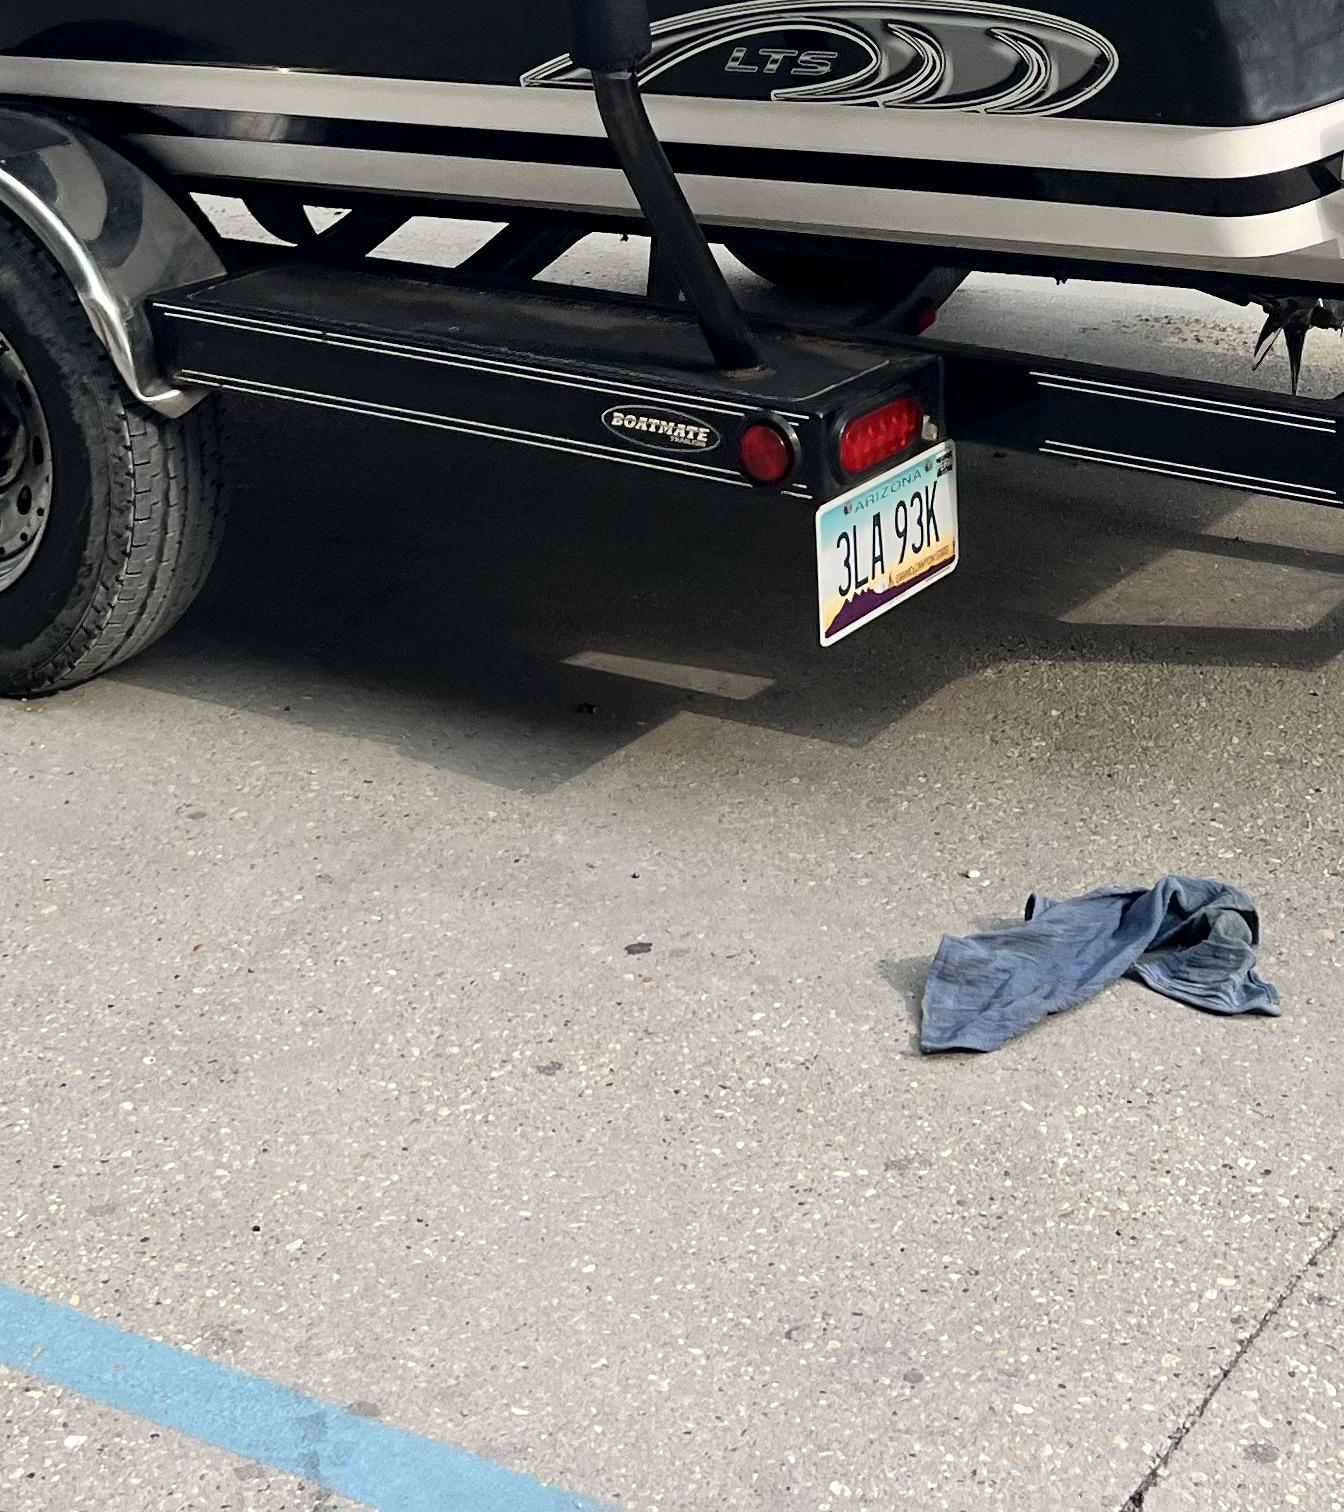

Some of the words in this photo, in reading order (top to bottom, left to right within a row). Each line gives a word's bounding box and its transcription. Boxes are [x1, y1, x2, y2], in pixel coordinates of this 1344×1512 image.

[723, 46, 839, 77] LTS
[611, 411, 710, 442] BOATMATE
[854, 470, 923, 513] ARIZONA
[836, 511, 886, 597] 3LA
[894, 480, 940, 565] 93K
